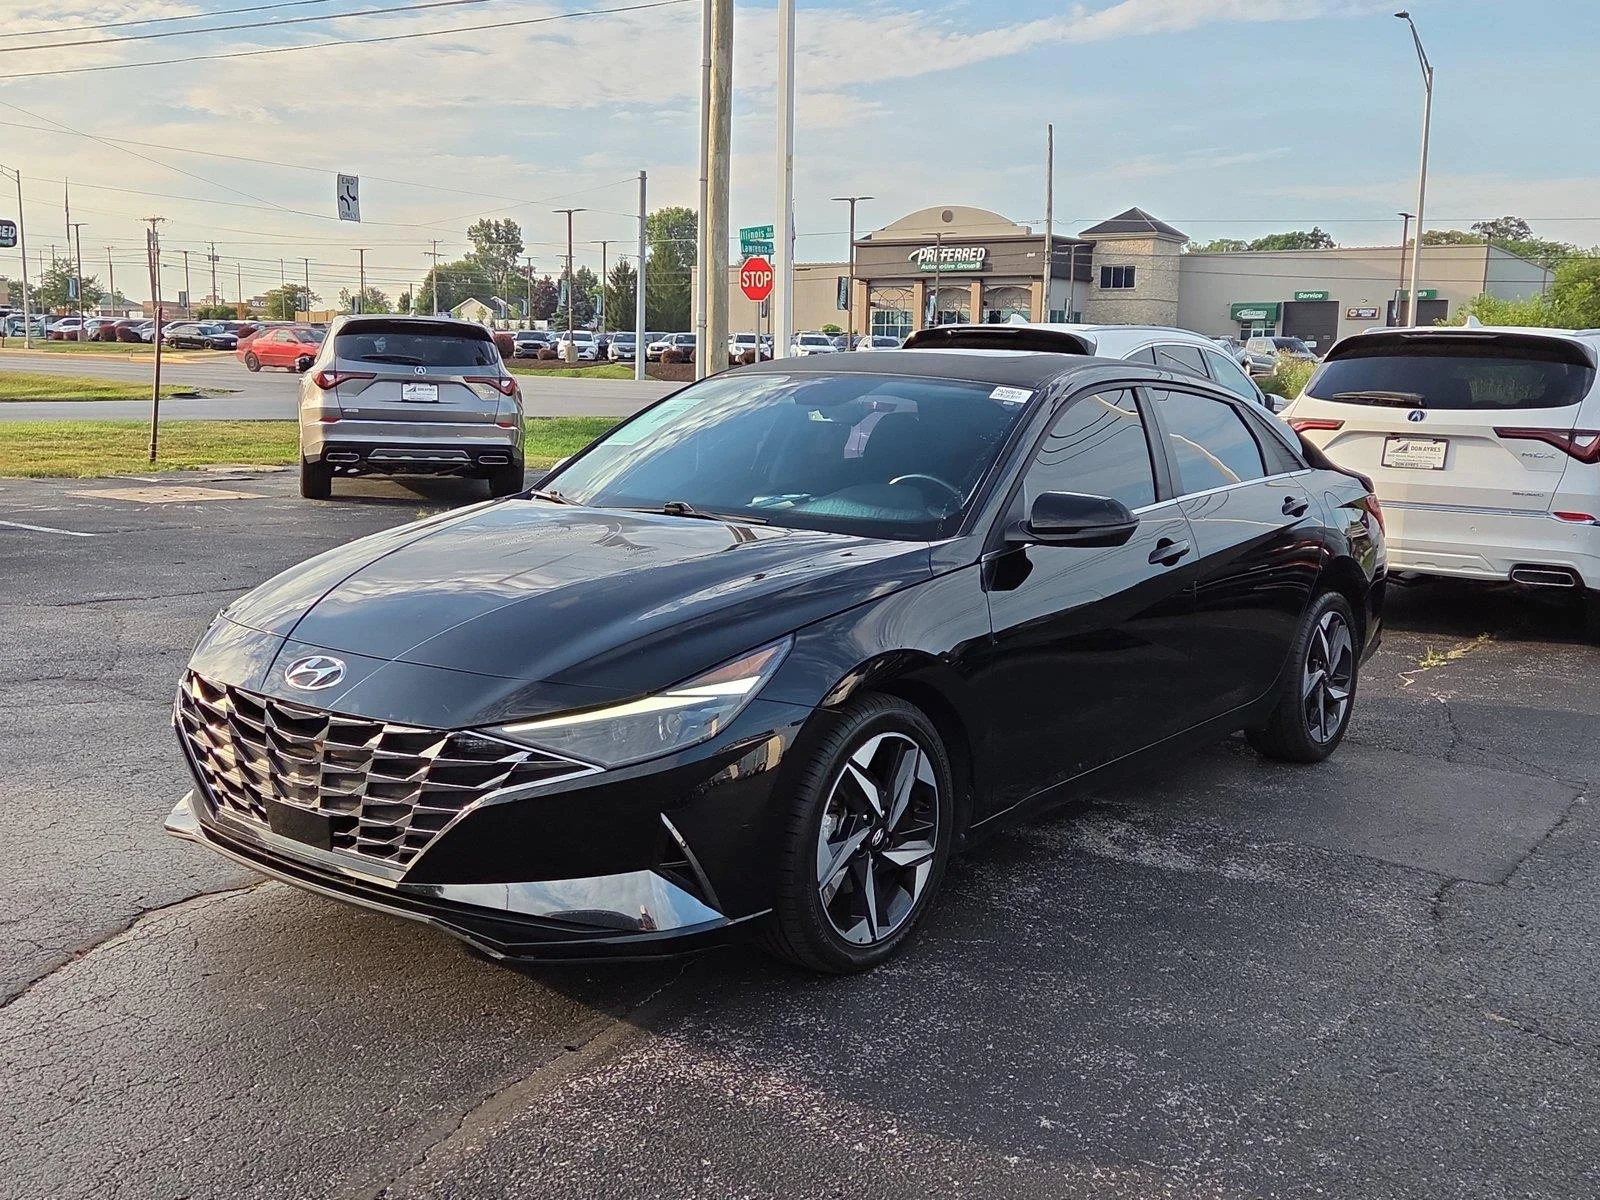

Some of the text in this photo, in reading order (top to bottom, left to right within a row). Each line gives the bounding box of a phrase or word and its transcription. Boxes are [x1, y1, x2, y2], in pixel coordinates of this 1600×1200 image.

[341, 177, 355, 185] END
[341, 211, 357, 219] ONLY
[740, 229, 765, 240] Illinois
[741, 243, 768, 253] Lawrence
[918, 247, 986, 263] PREFERRED
[742, 271, 771, 287] STOP
